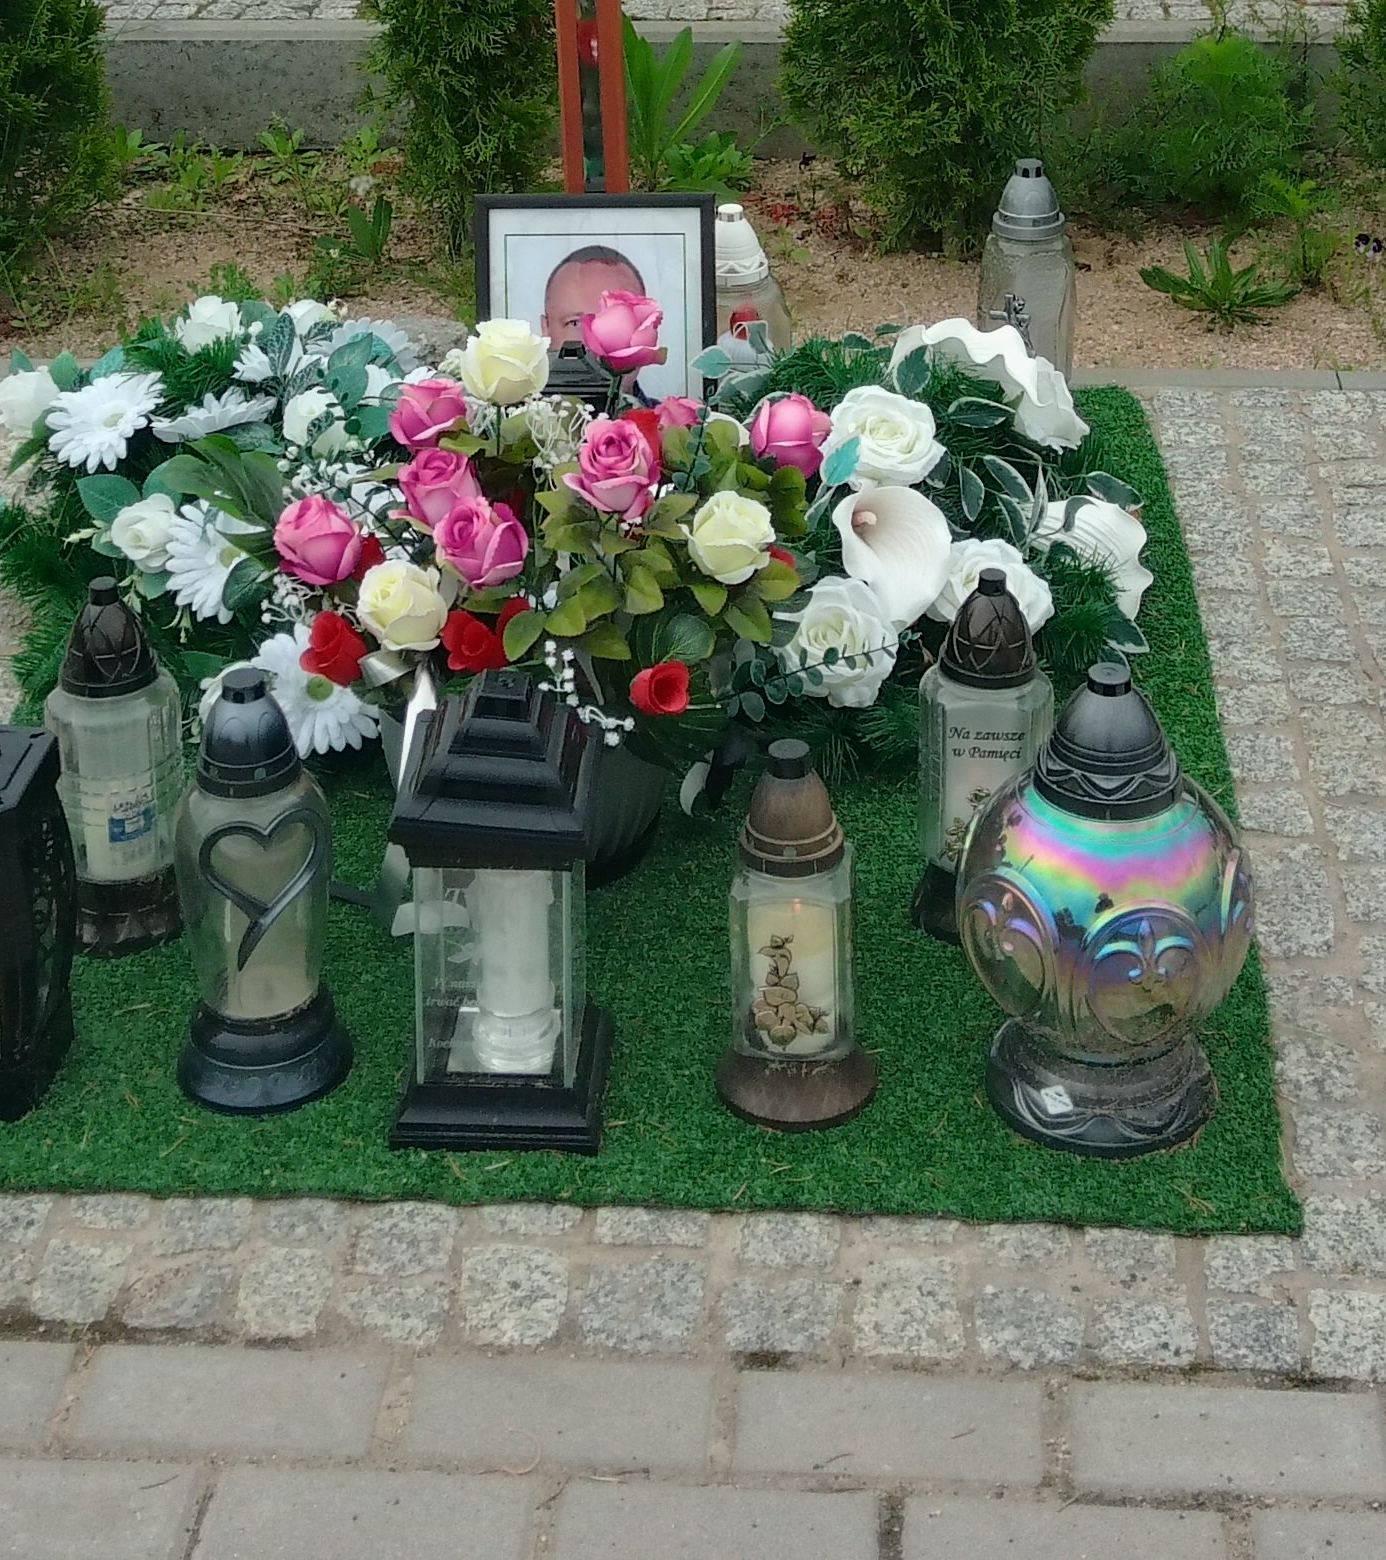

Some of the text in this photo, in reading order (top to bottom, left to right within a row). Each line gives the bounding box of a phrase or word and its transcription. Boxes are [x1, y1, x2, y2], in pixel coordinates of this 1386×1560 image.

[948, 725, 1026, 742] Na zawsze
[951, 746, 1023, 763] w Pamięci
